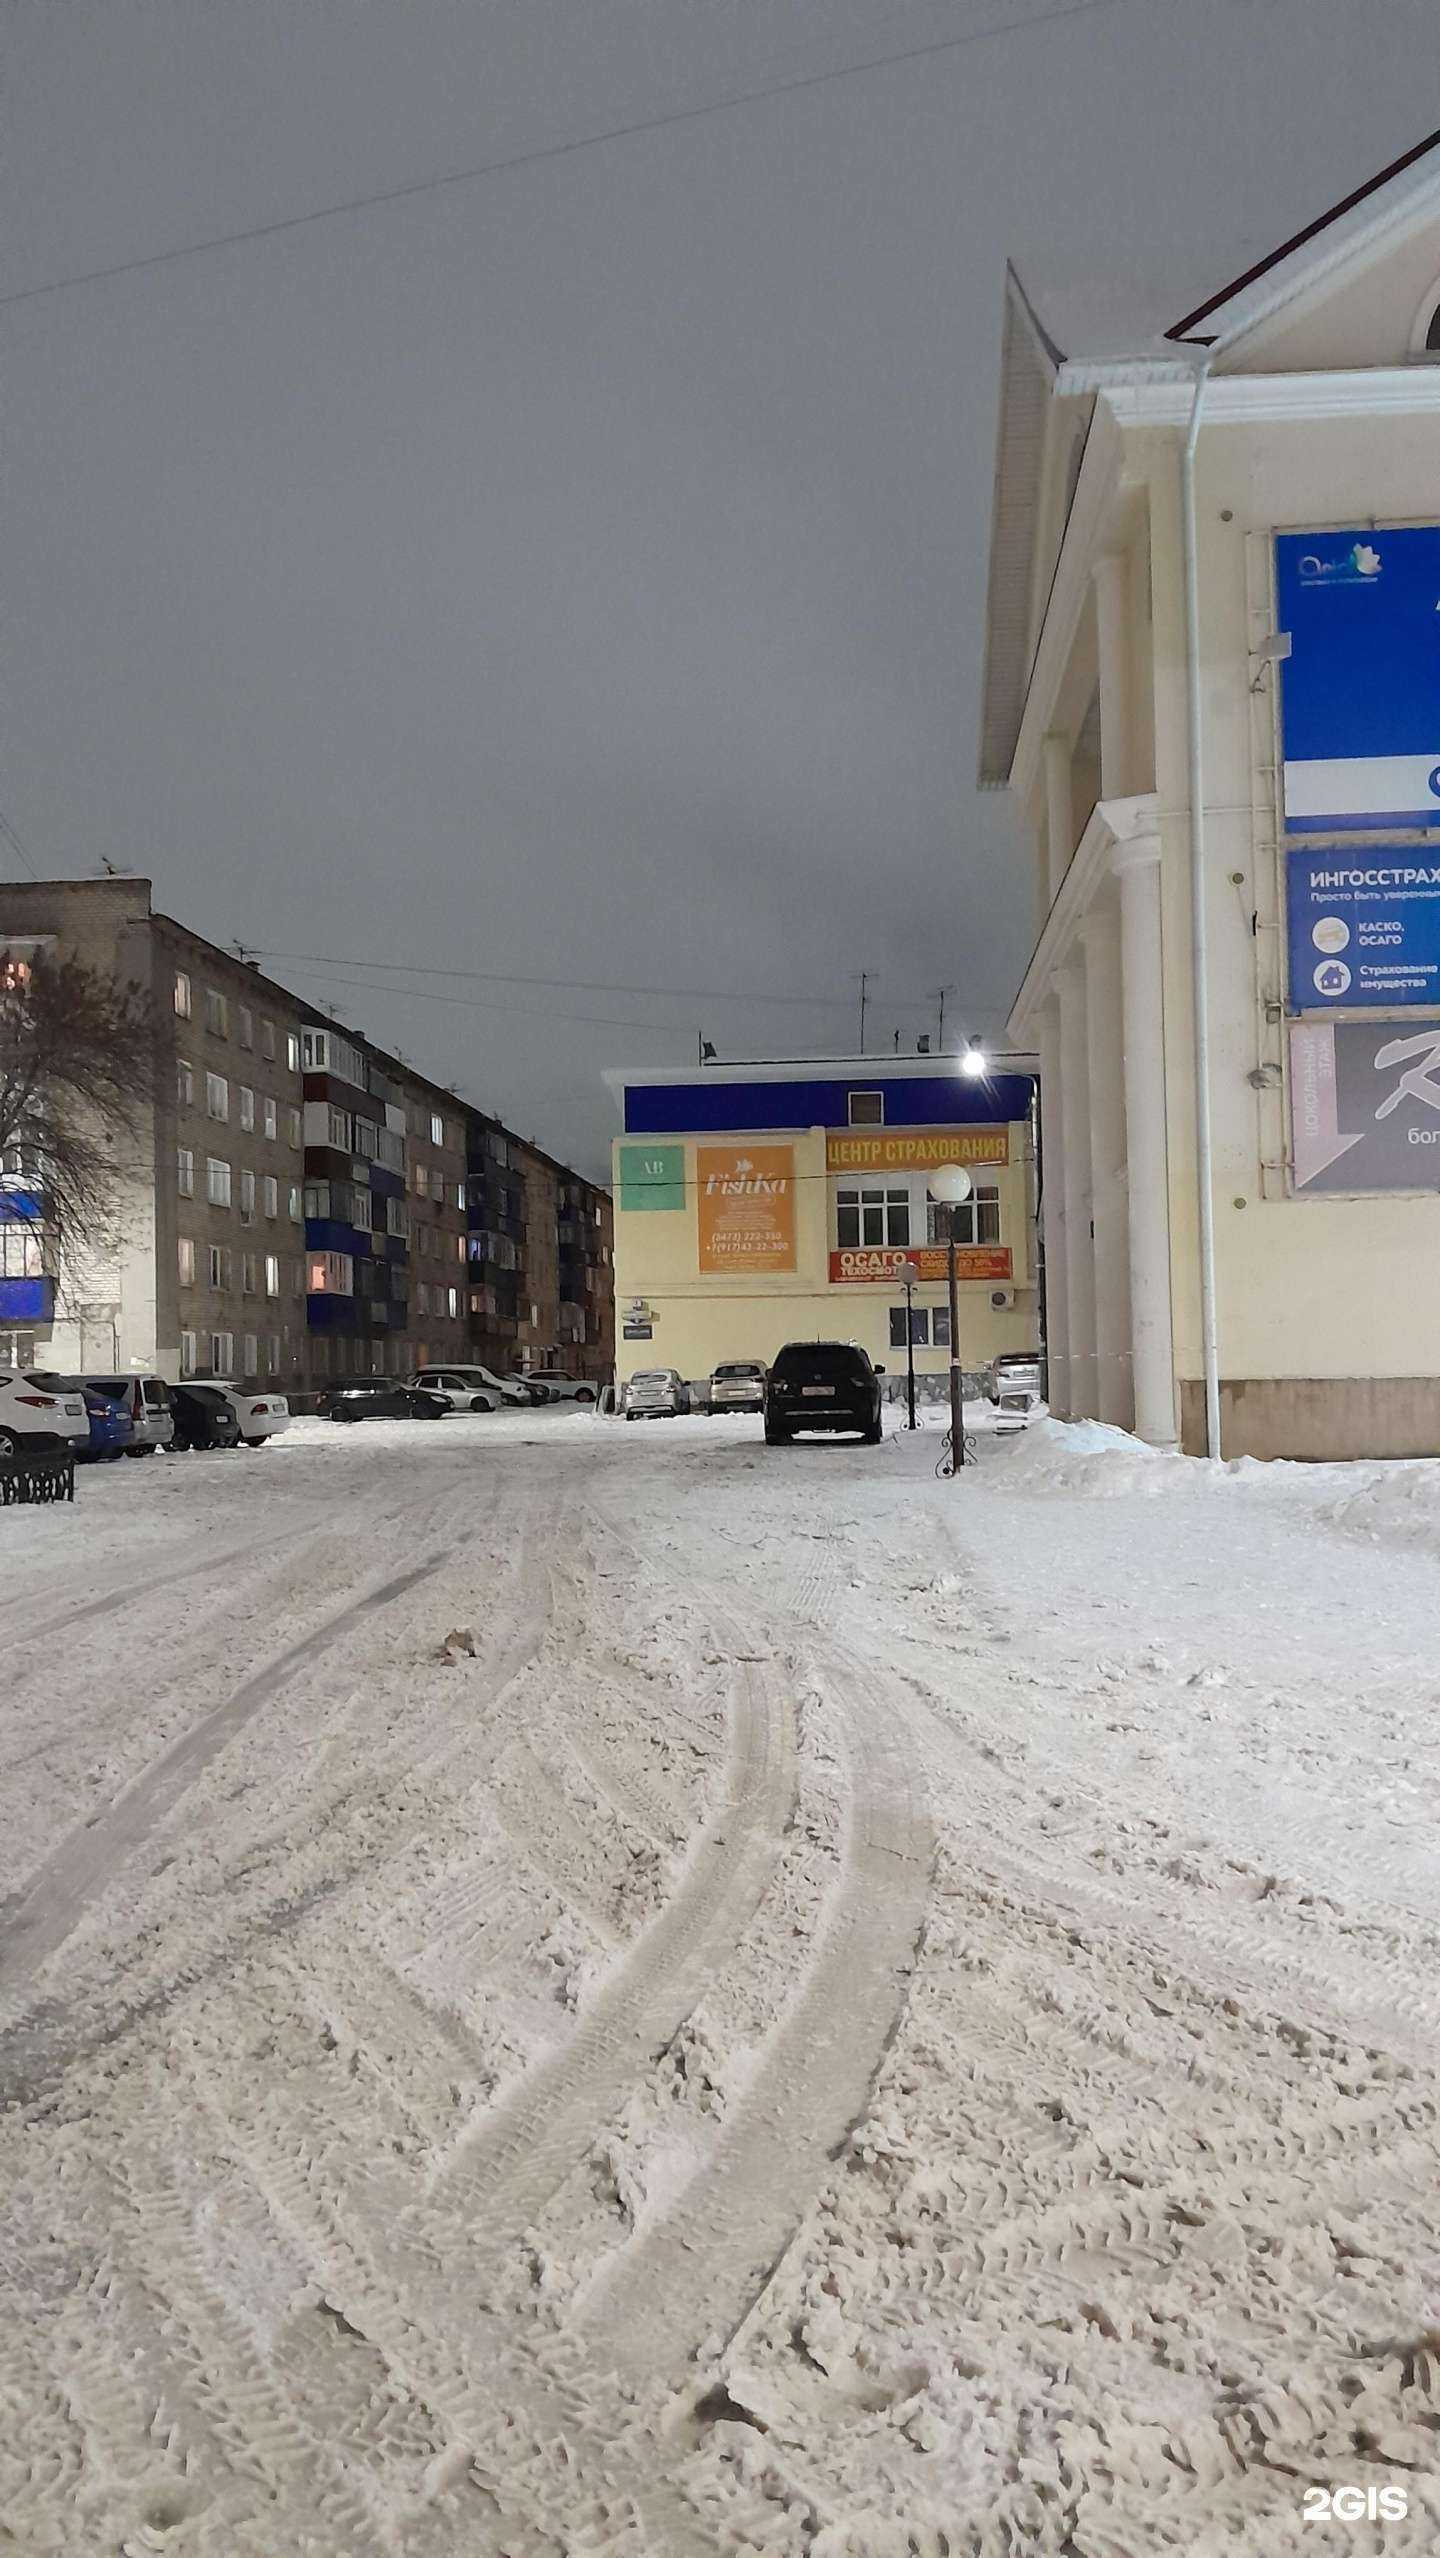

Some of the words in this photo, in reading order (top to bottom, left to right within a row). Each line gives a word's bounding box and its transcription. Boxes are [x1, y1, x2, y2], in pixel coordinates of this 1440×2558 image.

[1310, 868, 1440, 888] ИНГОССТРАХ
[1311, 891, 1352, 903] Просто
[1354, 891, 1381, 900] быть
[1359, 935, 1402, 946] ОСАГО
[1360, 964, 1438, 977] Страхование
[1319, 1039, 1331, 1079] ЭТАЖ
[1302, 1039, 1319, 1136] ЦОКОЛЬНЫЙ
[828, 1141, 881, 1165] ЦЕНТР
[886, 1137, 1006, 1161] СТРАХОВАНИЯ
[840, 1252, 907, 1267] ОСАГО
[840, 1266, 898, 1276] ТЕХОСМОТ
